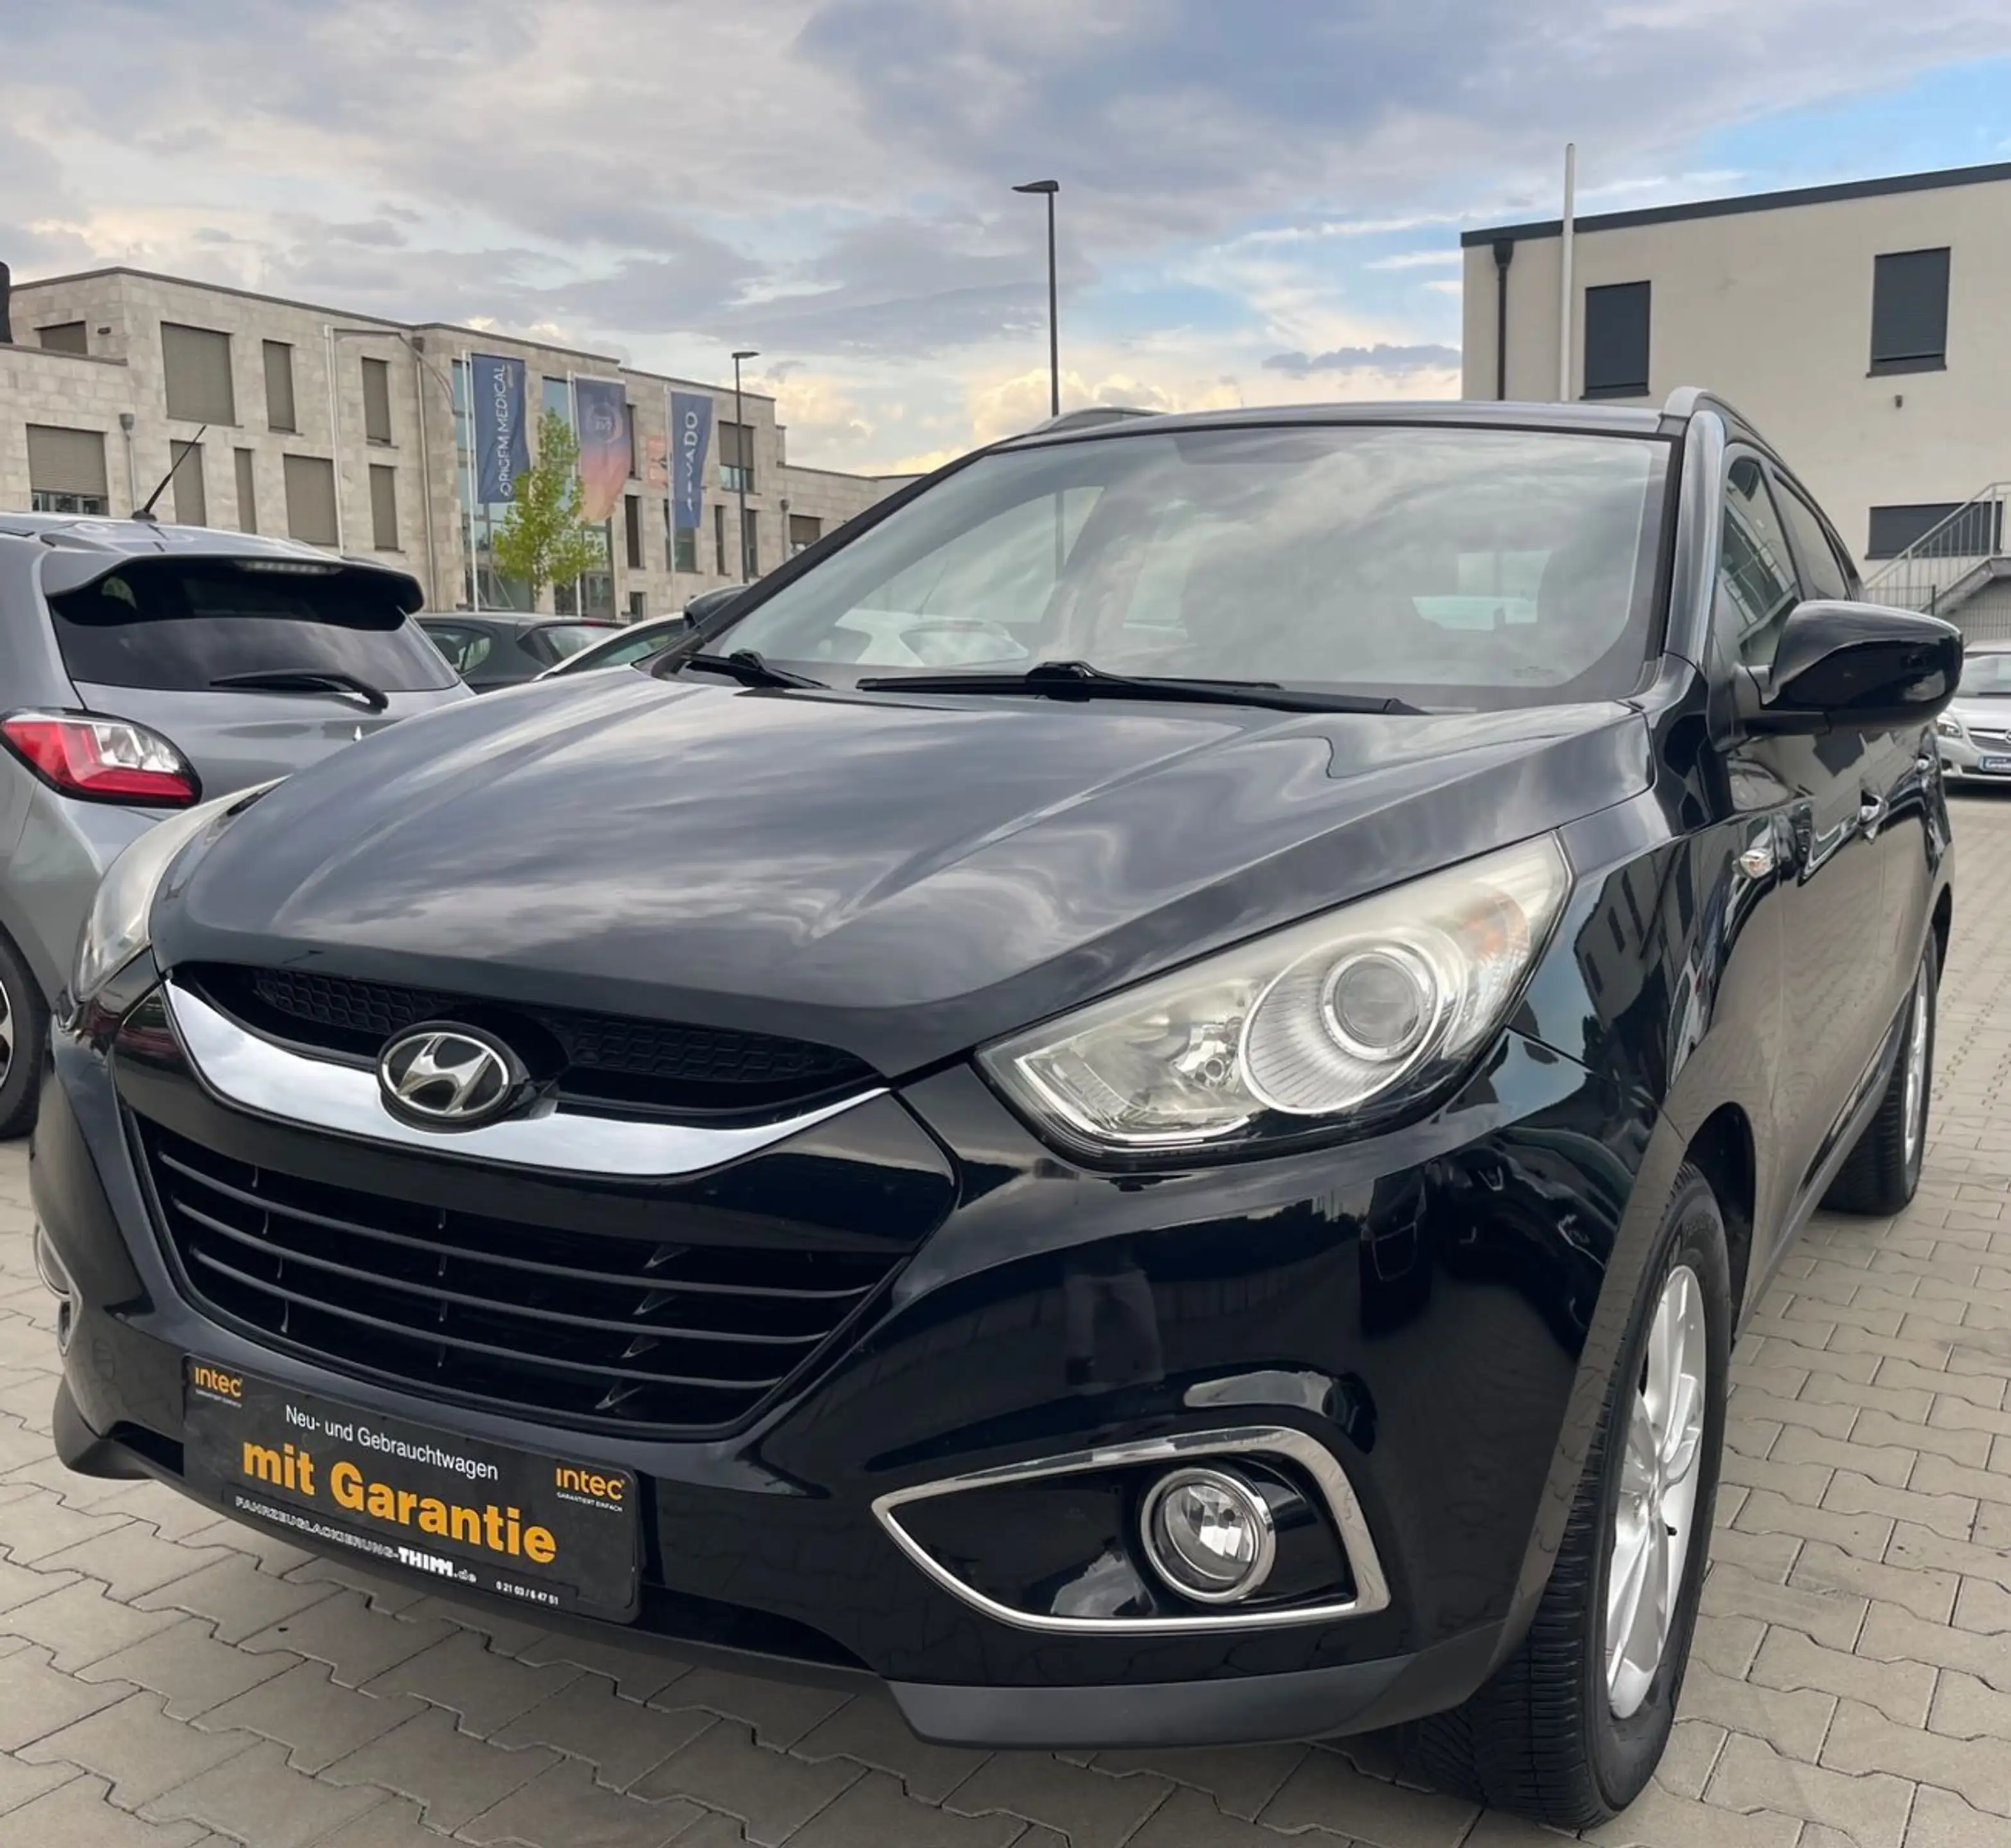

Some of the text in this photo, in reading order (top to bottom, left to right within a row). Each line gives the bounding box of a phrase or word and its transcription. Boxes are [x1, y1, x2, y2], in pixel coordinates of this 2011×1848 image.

[493, 364, 509, 432] MEDICAL
[286, 1405, 499, 1481] Neu- und Gebrauchtwagen
[243, 1441, 556, 1563] mit Garantie
